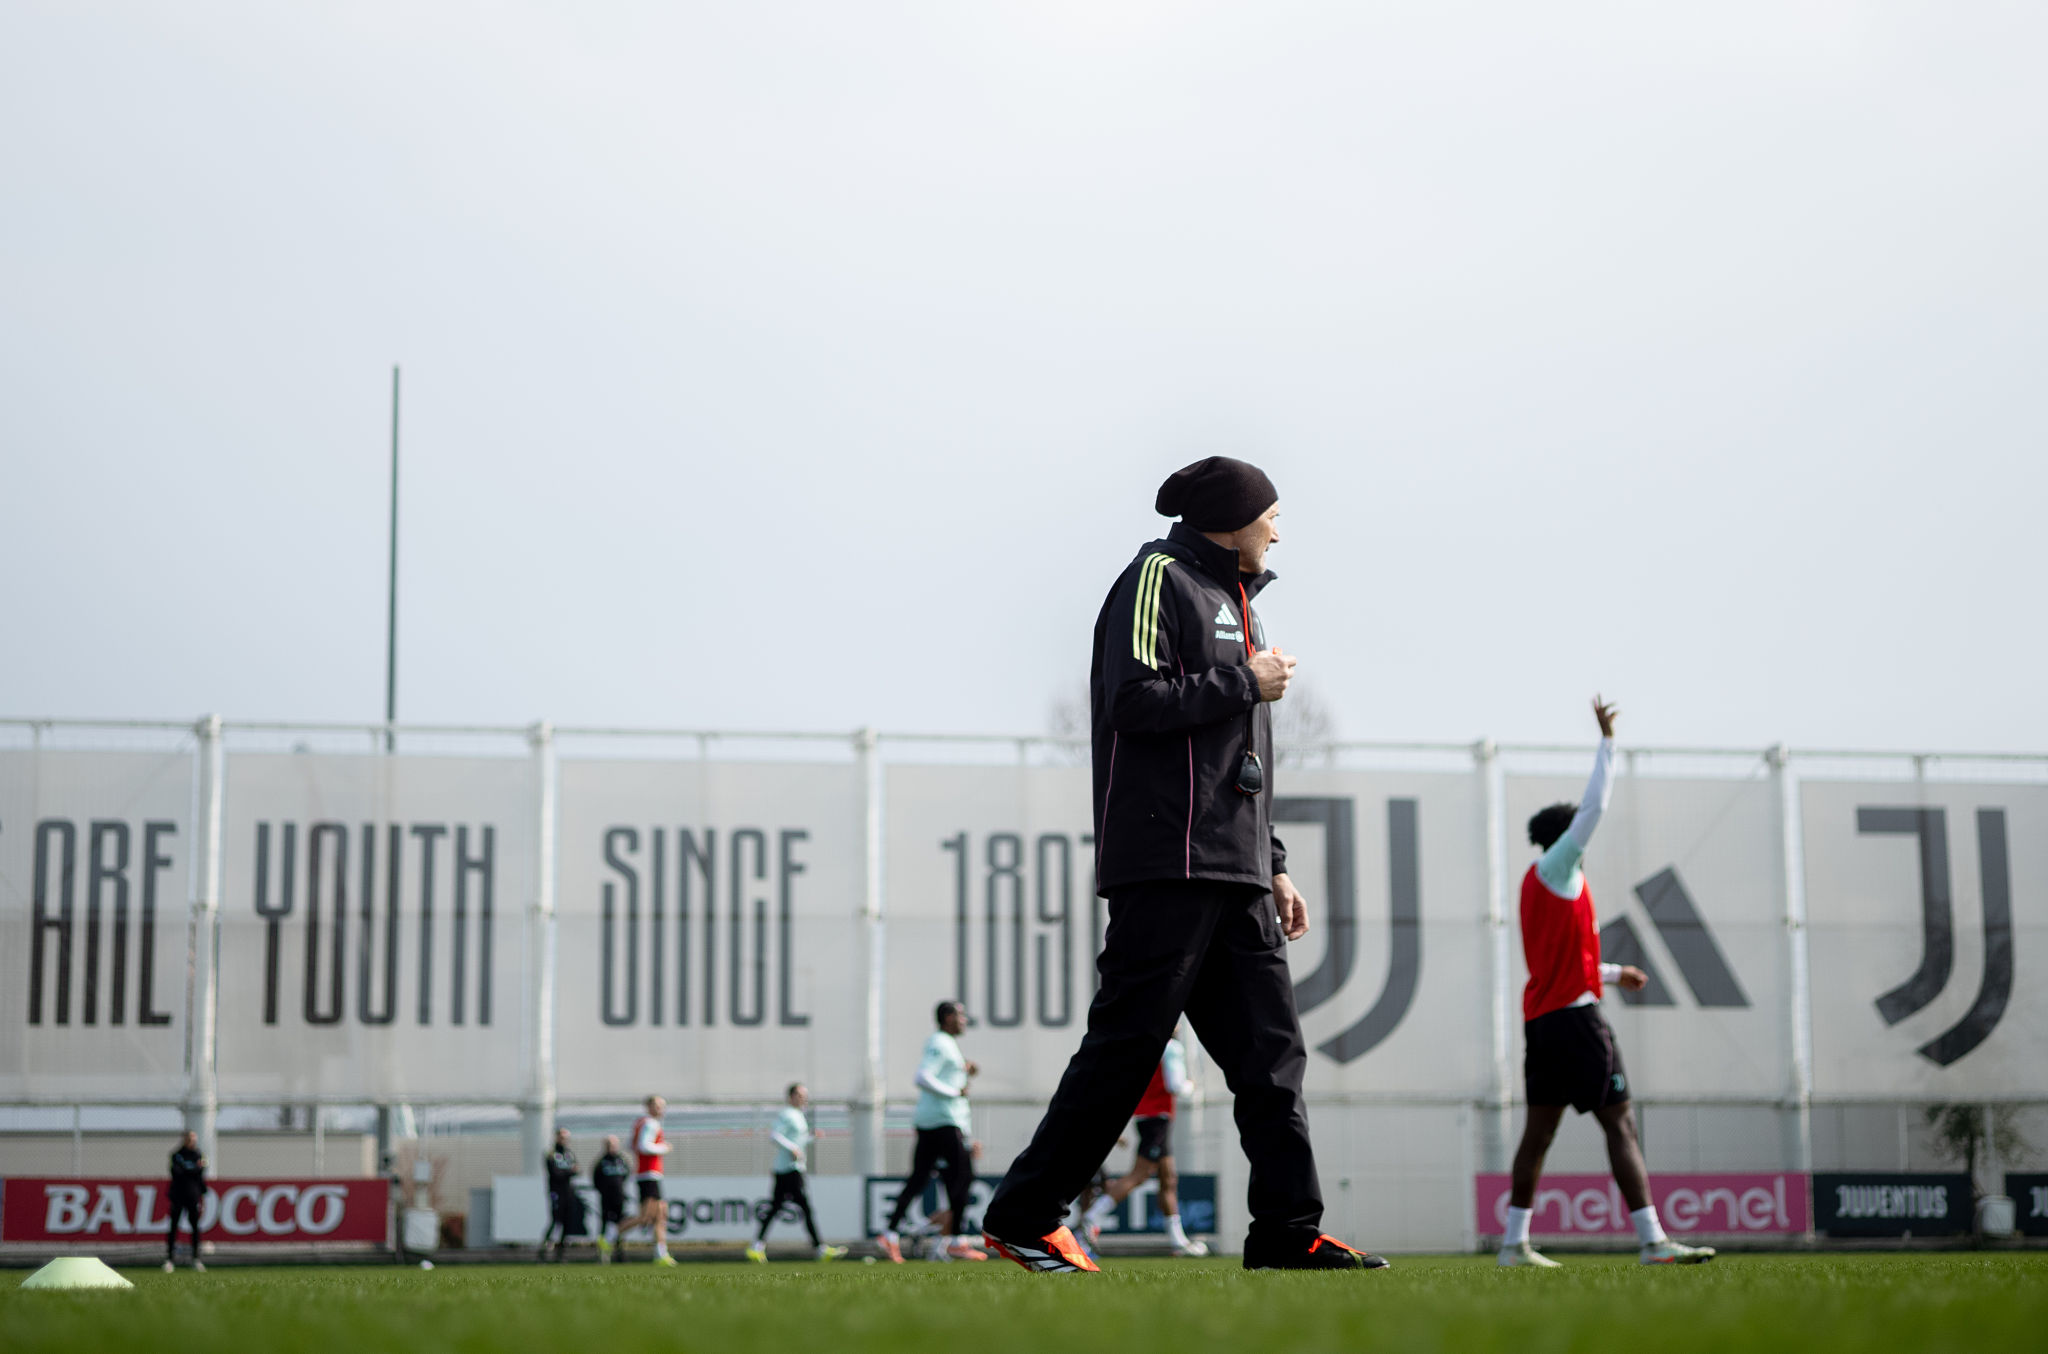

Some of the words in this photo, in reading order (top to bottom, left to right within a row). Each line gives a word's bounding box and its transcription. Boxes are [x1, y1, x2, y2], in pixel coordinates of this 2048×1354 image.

[28, 818, 178, 1027] ARE
[254, 821, 496, 1028] YOUTH
[601, 827, 812, 1028] SINCE
[1664, 1175, 1791, 1230] enel
[1835, 1184, 1949, 1219] JUVENTUS
